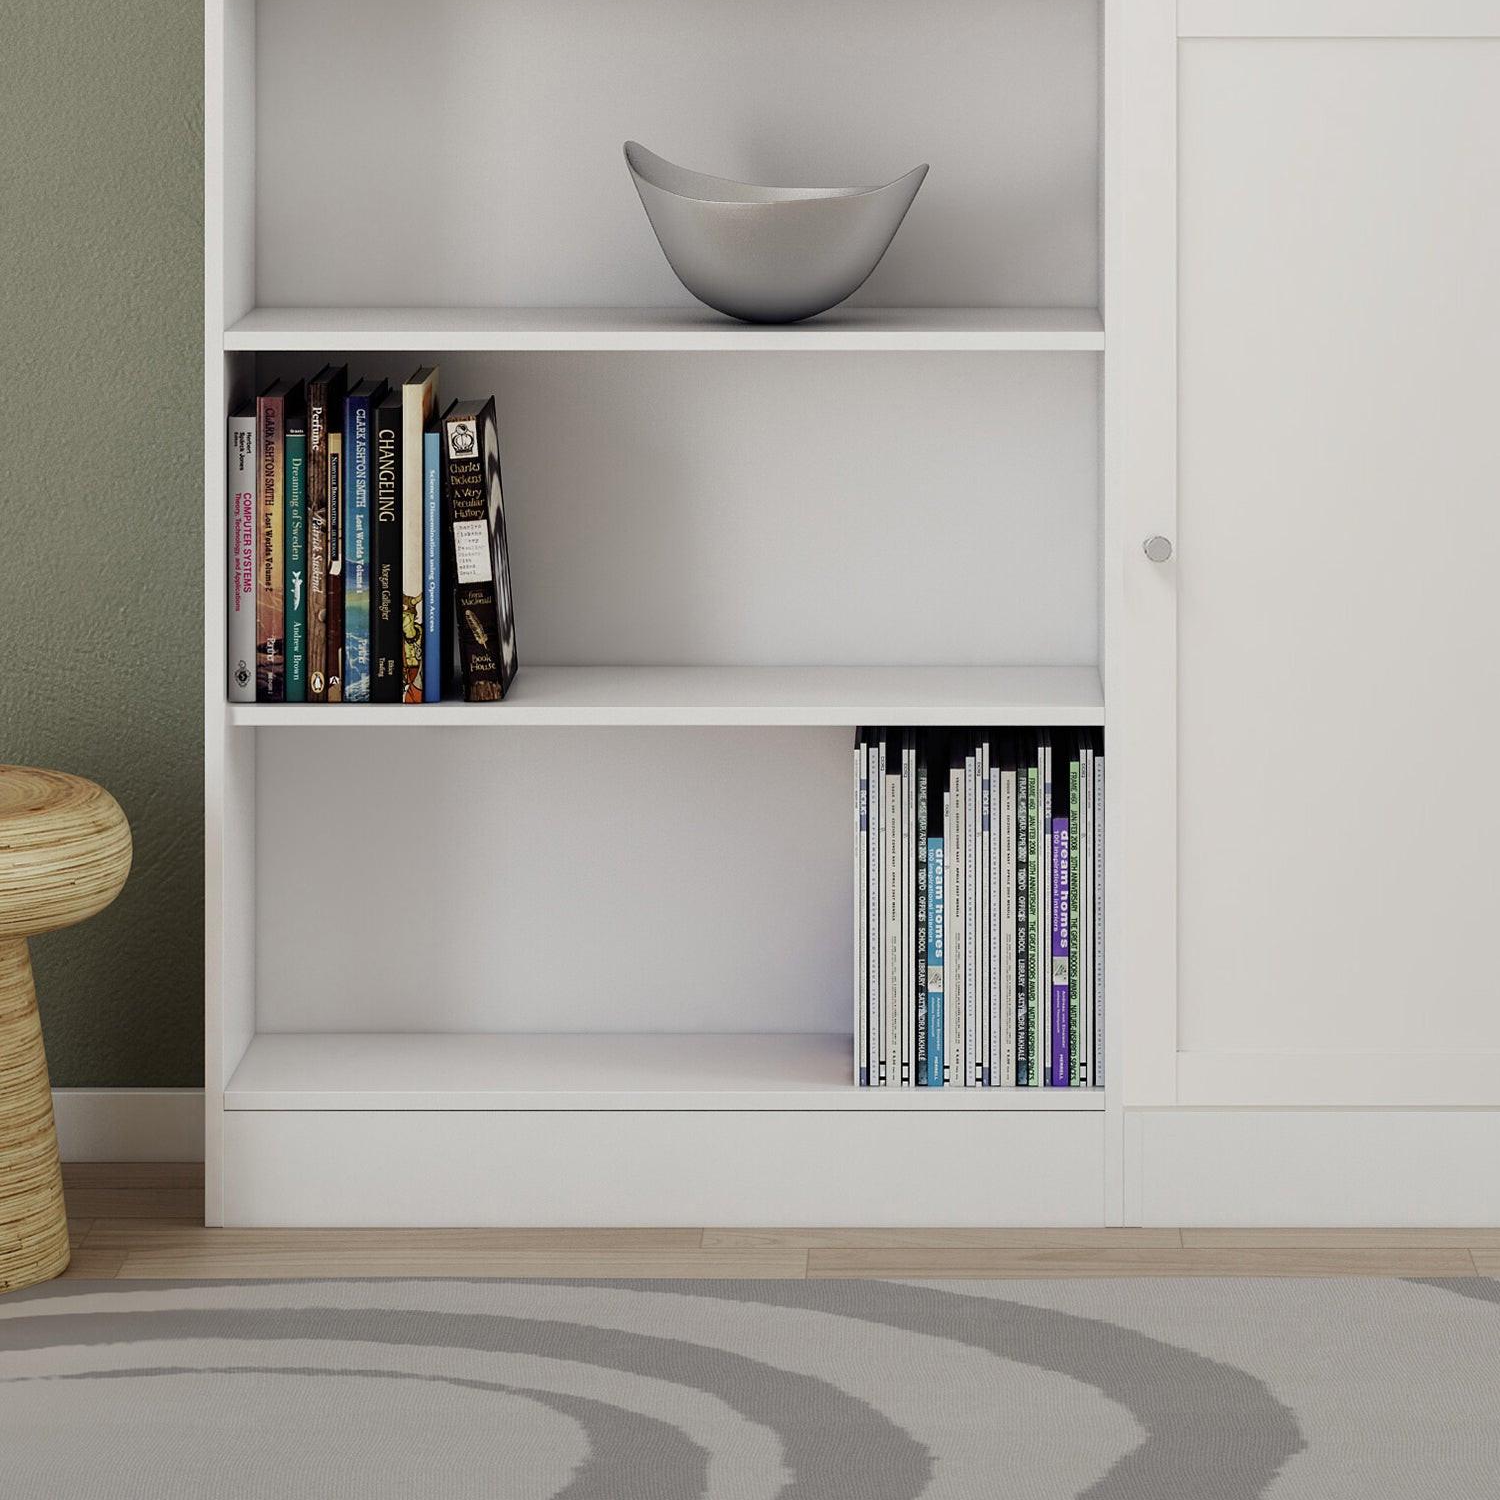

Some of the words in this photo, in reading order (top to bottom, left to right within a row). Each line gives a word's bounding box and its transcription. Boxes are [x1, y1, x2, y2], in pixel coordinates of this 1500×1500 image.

[264, 408, 274, 439] CLARK
[312, 407, 322, 451] Perfume
[356, 408, 366, 439] CLARK
[264, 440, 274, 477] ASHTON
[356, 440, 366, 478] ASHTON
[290, 457, 302, 508] Dreaming
[379, 429, 395, 522] CHANGELING
[429, 469, 437, 499] Science
[264, 478, 274, 506] SMITH
[356, 479, 366, 508] SMITH
[243, 493, 252, 546] COMPUTER
[264, 512, 274, 529] Lost
[293, 509, 303, 519] of
[356, 514, 364, 531] Lost
[234, 517, 242, 557] Technology,
[264, 530, 274, 556] Worlds
[292, 521, 302, 561] Sweden
[311, 517, 323, 551] Patrick
[429, 502, 437, 557] Dissemination
[356, 532, 364, 559] Worlds
[243, 548, 252, 593] SYSTEMS
[264, 558, 274, 586] Volume
[311, 553, 323, 594] Suskind
[356, 560, 364, 589] Volume
[379, 563, 391, 589] Morgan
[429, 558, 437, 580] using
[234, 570, 242, 611] Applications
[429, 581, 437, 604] Open
[379, 590, 391, 621] Gallagher
[429, 605, 437, 633] Access
[294, 621, 302, 651] Andrew
[294, 654, 302, 681] Brown
[1018, 777, 1026, 799] FRAME
[1070, 771, 1078, 793] FRAME
[1018, 815, 1026, 846] MAR/APR
[1018, 868, 1026, 891] TOKYO
[1018, 896, 1026, 922] OFFICES
[1070, 918, 1078, 929] THE
[1018, 927, 1026, 953] SCHOOL
[1070, 930, 1078, 951] GREAT
[1018, 959, 1026, 987] LIBRARY
[1018, 1032, 1026, 1061] PAKHALÉ
